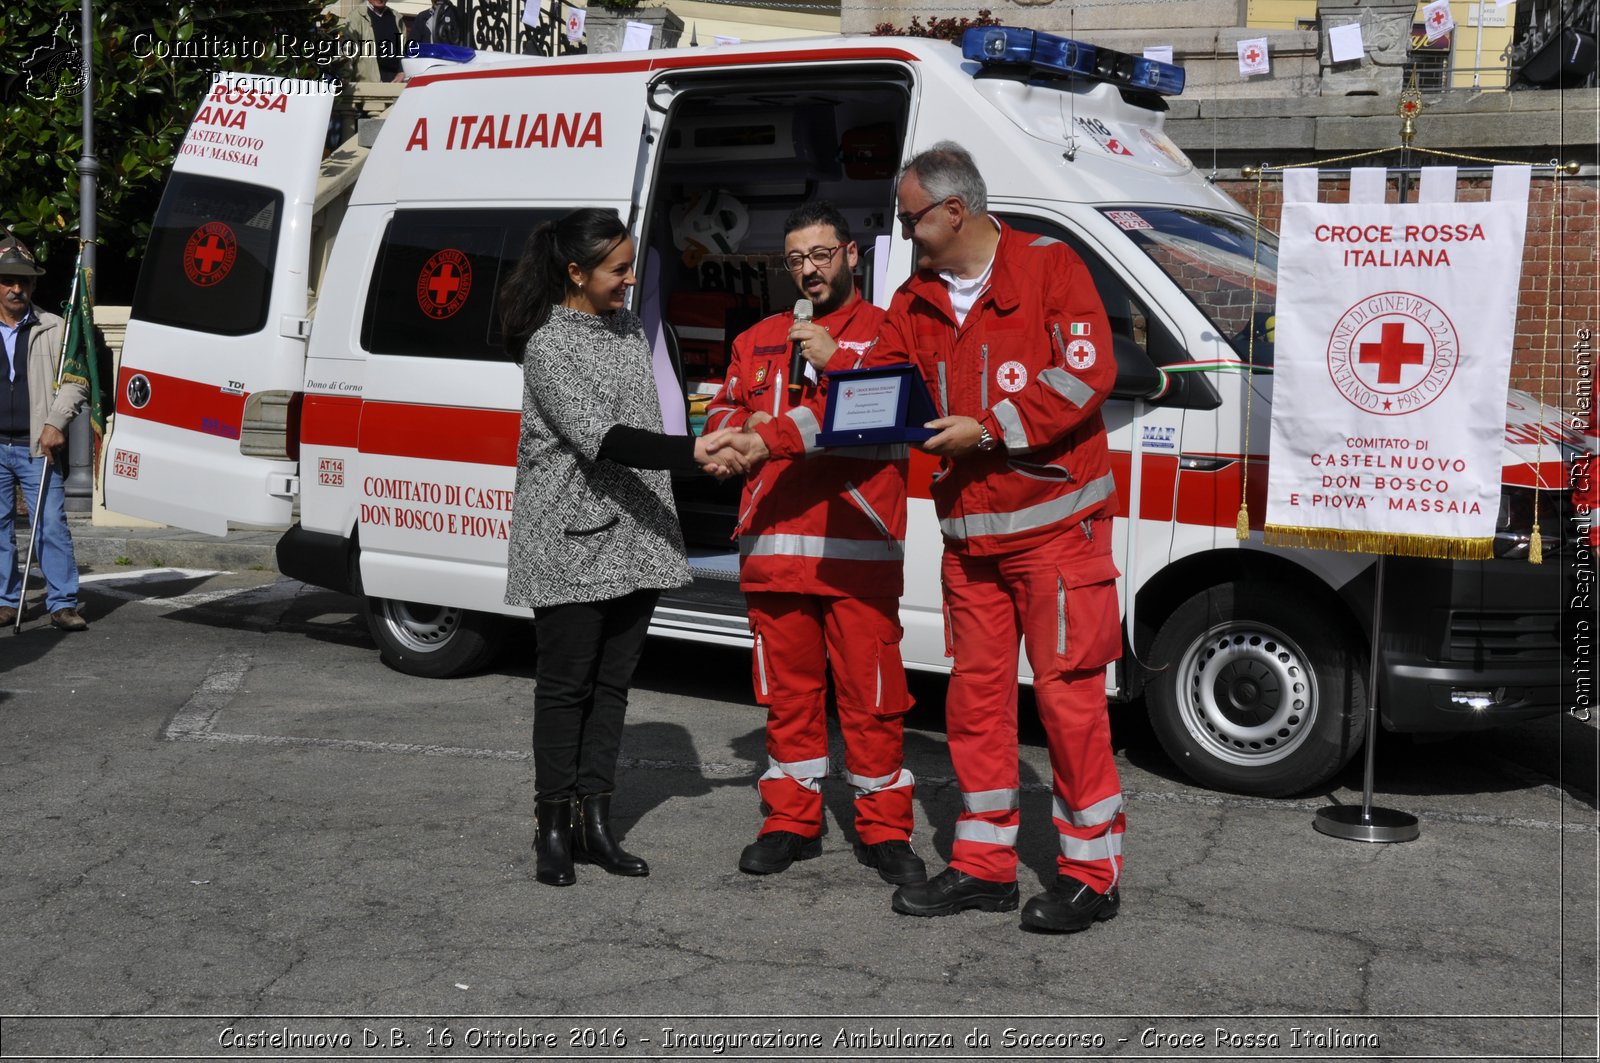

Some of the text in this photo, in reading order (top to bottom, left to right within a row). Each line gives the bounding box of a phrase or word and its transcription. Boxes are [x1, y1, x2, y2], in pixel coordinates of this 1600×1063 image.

[210, 84, 288, 113] ROSSA
[406, 112, 602, 152] A ITALIANA
[1080, 118, 1112, 136] 118
[210, 148, 258, 167] MASSAIA
[1315, 224, 1486, 243] CROCE ROSSA
[1344, 249, 1451, 267] ITALIANA
[1331, 296, 1453, 409] CONVENZIONE DI GINEVRA 22 AGOSTO 1864
[307, 380, 362, 392] Dono di Corno
[1142, 426, 1175, 440] MAF
[1346, 438, 1428, 450] COMITATO DI
[116, 452, 138, 464] AT 14
[320, 460, 342, 471] AT 14
[1310, 454, 1466, 472] CASTELNUOVO
[114, 464, 137, 478] 12-25
[320, 472, 343, 484] 12-25
[364, 476, 441, 503] COMITATO
[445, 485, 461, 506] DI
[1322, 475, 1449, 493] DON BOSCO
[1290, 494, 1299, 506] E
[1389, 499, 1481, 515] MASSAIA
[361, 504, 390, 526] DON
[395, 508, 444, 533] BOSCO
[448, 514, 457, 534] E
